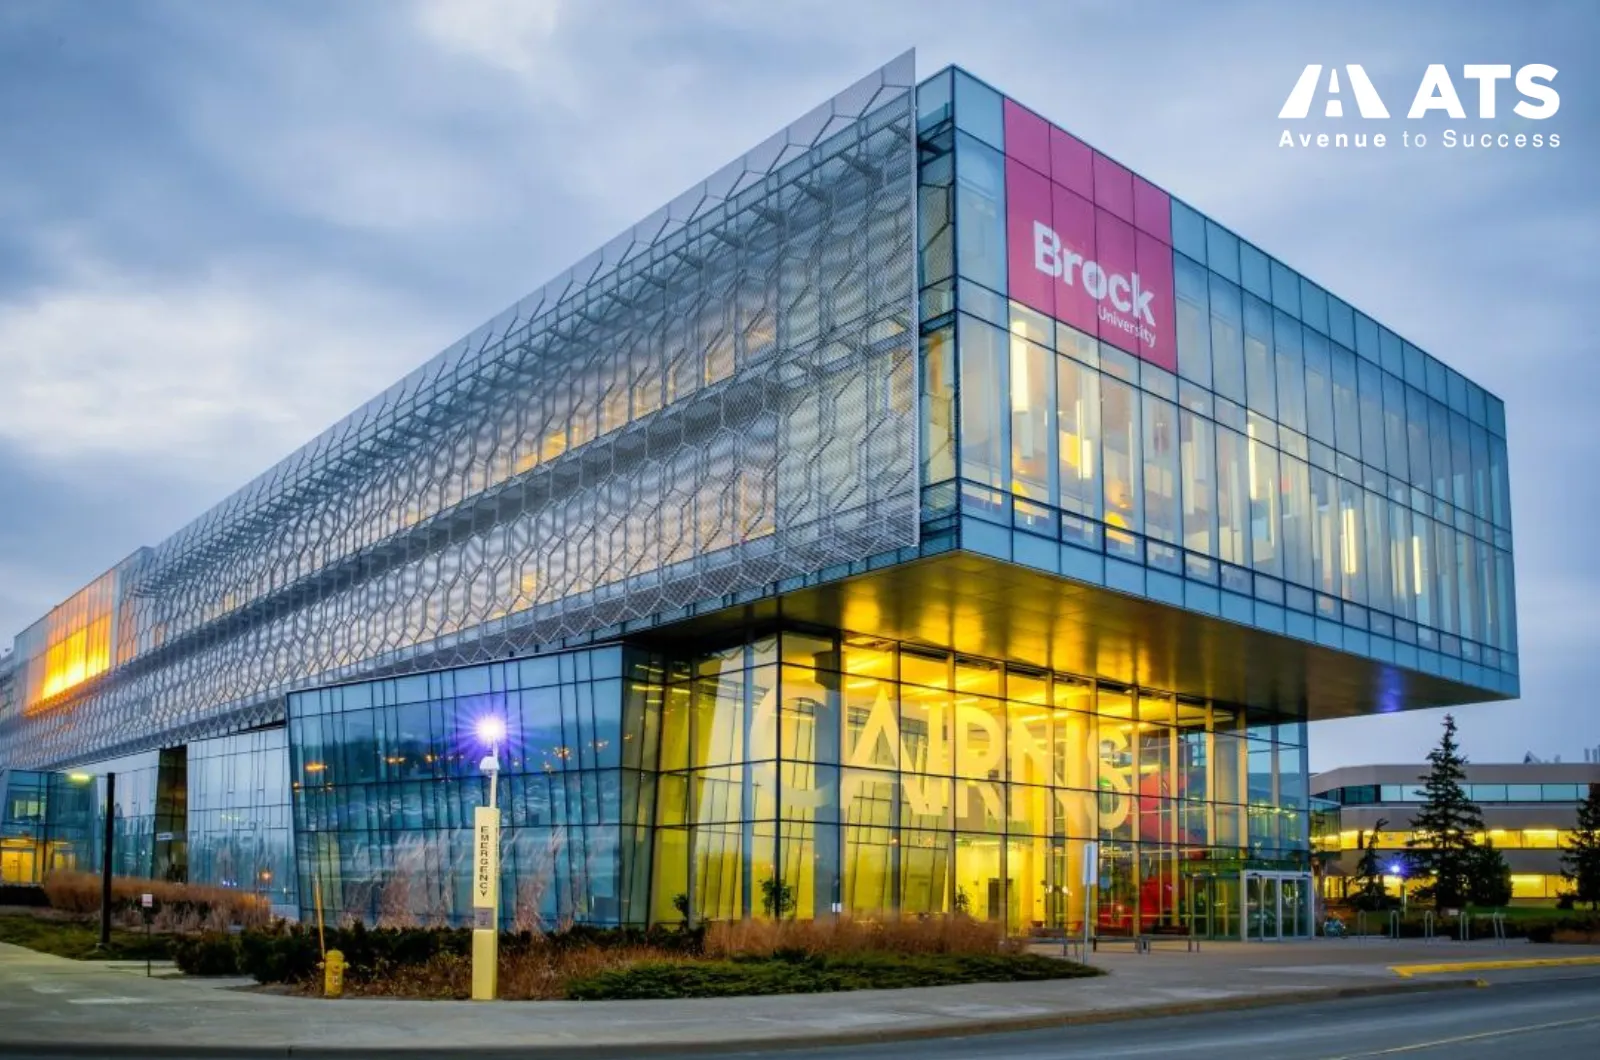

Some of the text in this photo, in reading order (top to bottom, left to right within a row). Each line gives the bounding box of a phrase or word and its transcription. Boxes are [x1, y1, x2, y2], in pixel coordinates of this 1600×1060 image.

[1033, 219, 1156, 326] Brock
[1098, 305, 1157, 348] University
[749, 680, 1133, 829] CAIRNS
[479, 825, 489, 897] EMERGENCY
